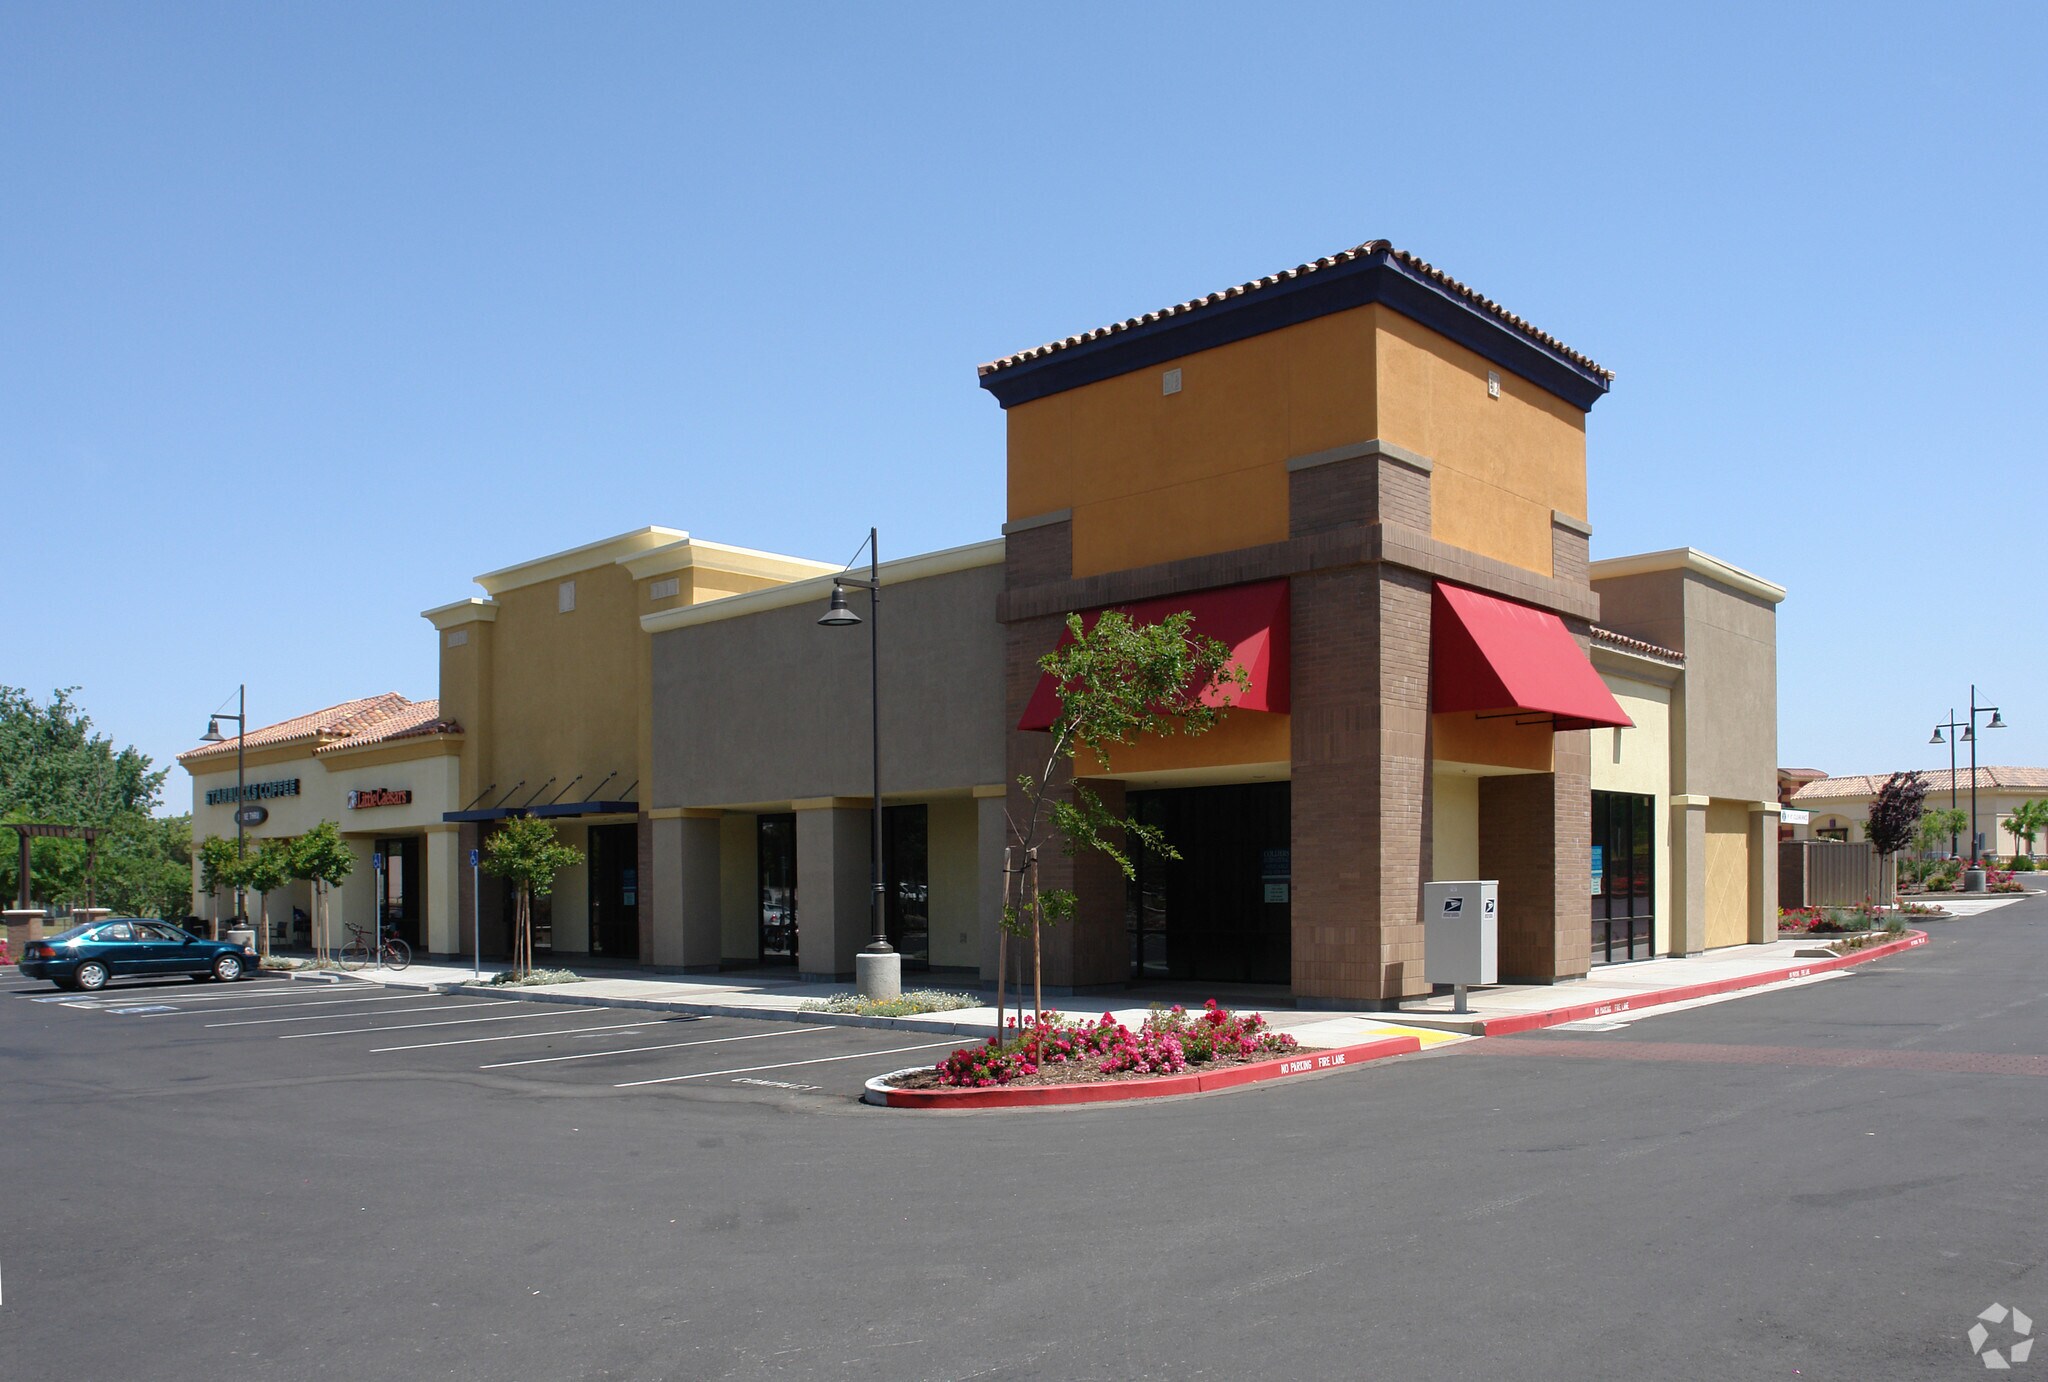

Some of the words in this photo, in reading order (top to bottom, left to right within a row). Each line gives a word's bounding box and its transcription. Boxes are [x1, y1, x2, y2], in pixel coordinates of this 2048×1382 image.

[260, 779, 300, 799] COFFEE
[1280, 1063, 1289, 1074] NO
[1290, 1060, 1312, 1072] PARKING
[1318, 1056, 1331, 1067] FIRE
[1332, 1054, 1345, 1066] LANE
